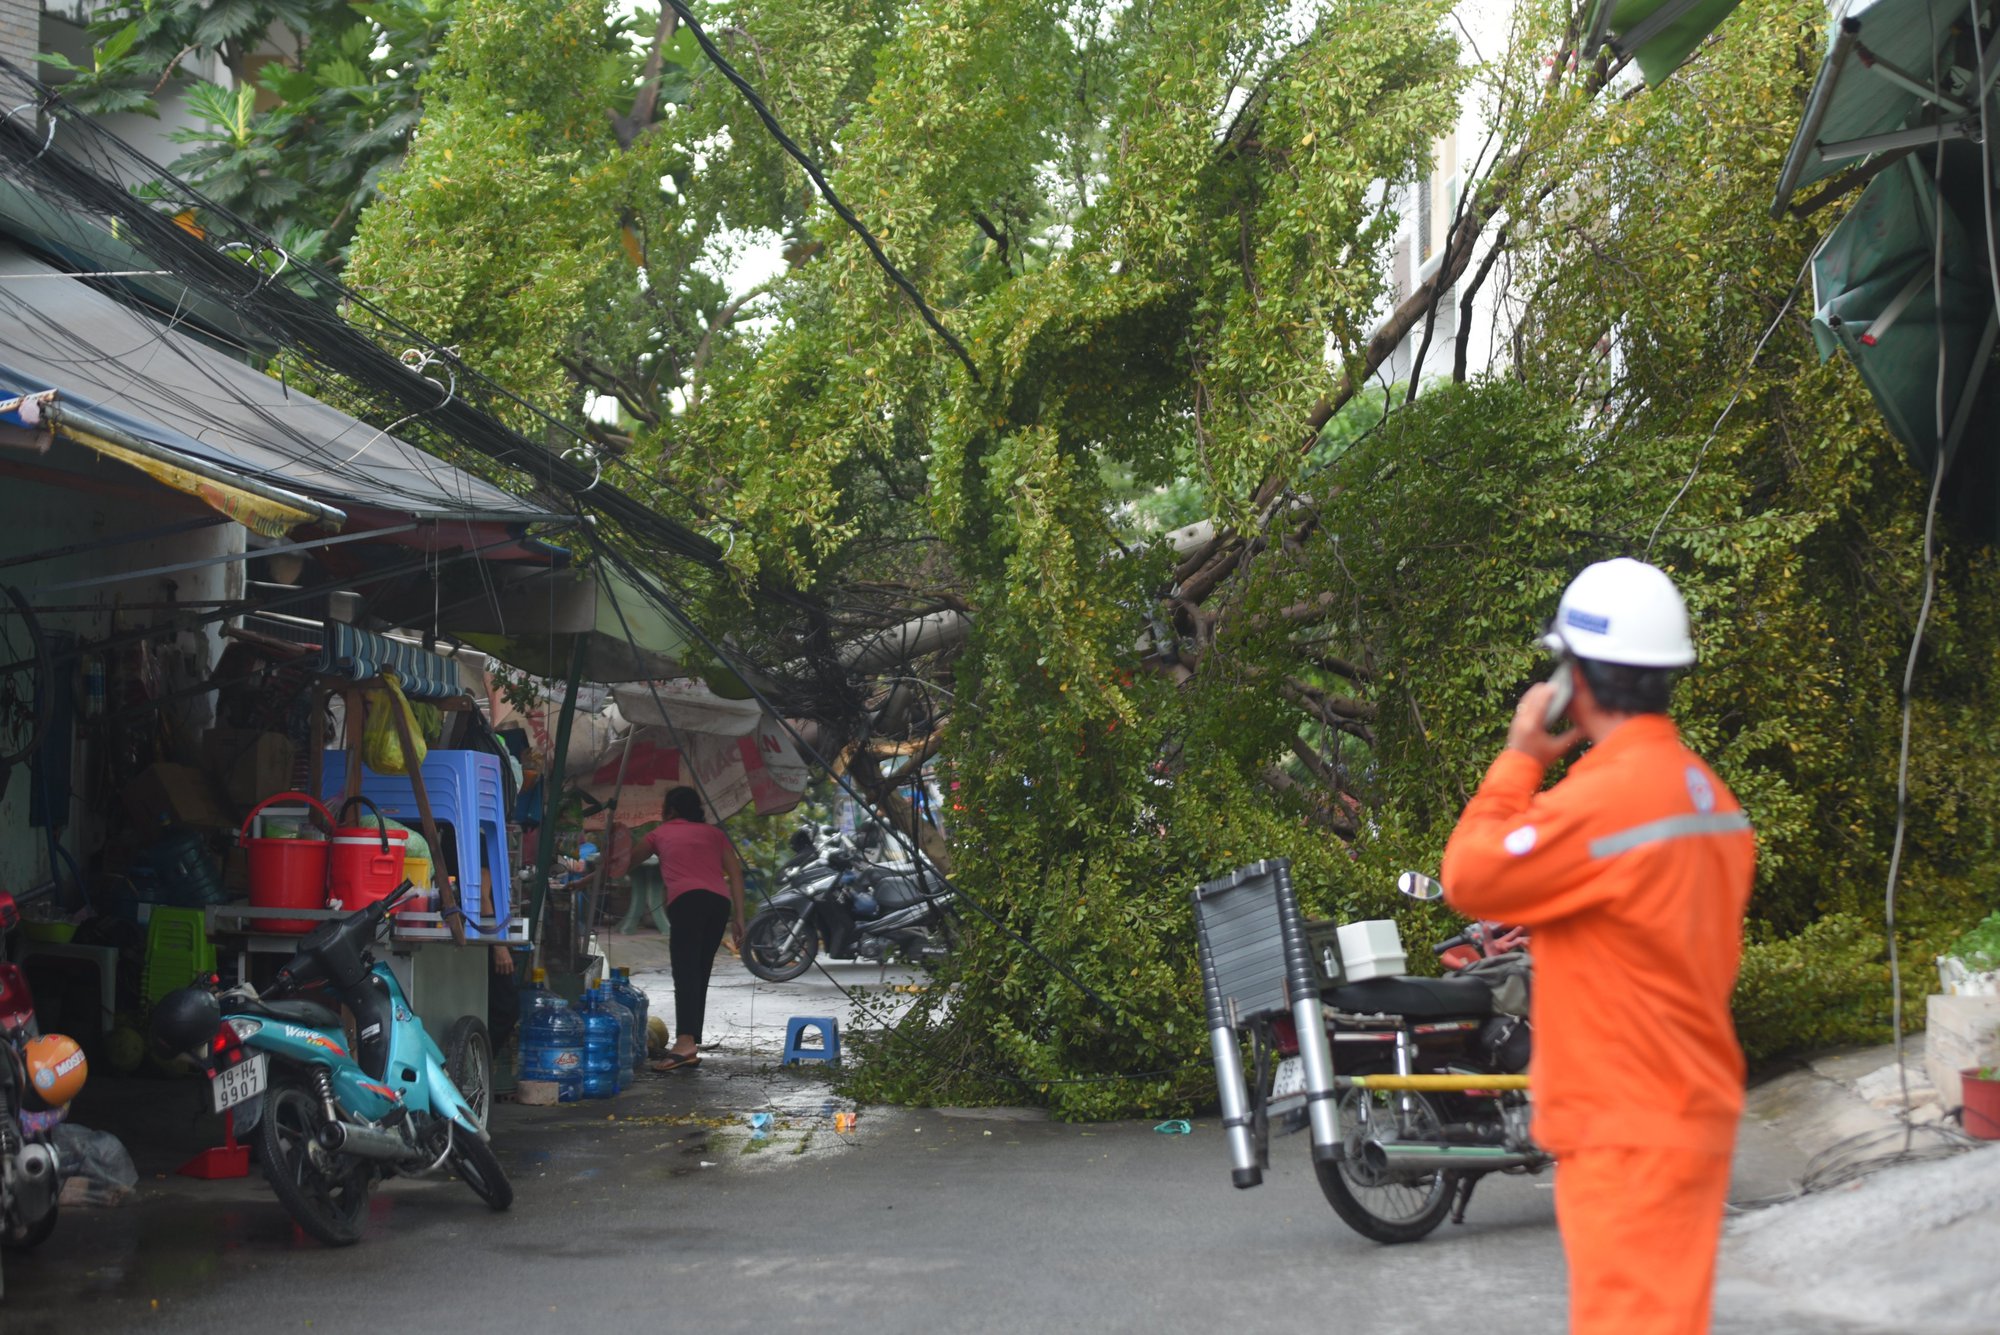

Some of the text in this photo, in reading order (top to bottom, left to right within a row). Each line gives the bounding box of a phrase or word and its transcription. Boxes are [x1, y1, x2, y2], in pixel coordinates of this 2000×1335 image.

[285, 1024, 320, 1040] Wave
[220, 1059, 256, 1089] 19-H4
[221, 1076, 257, 1107] 9907
